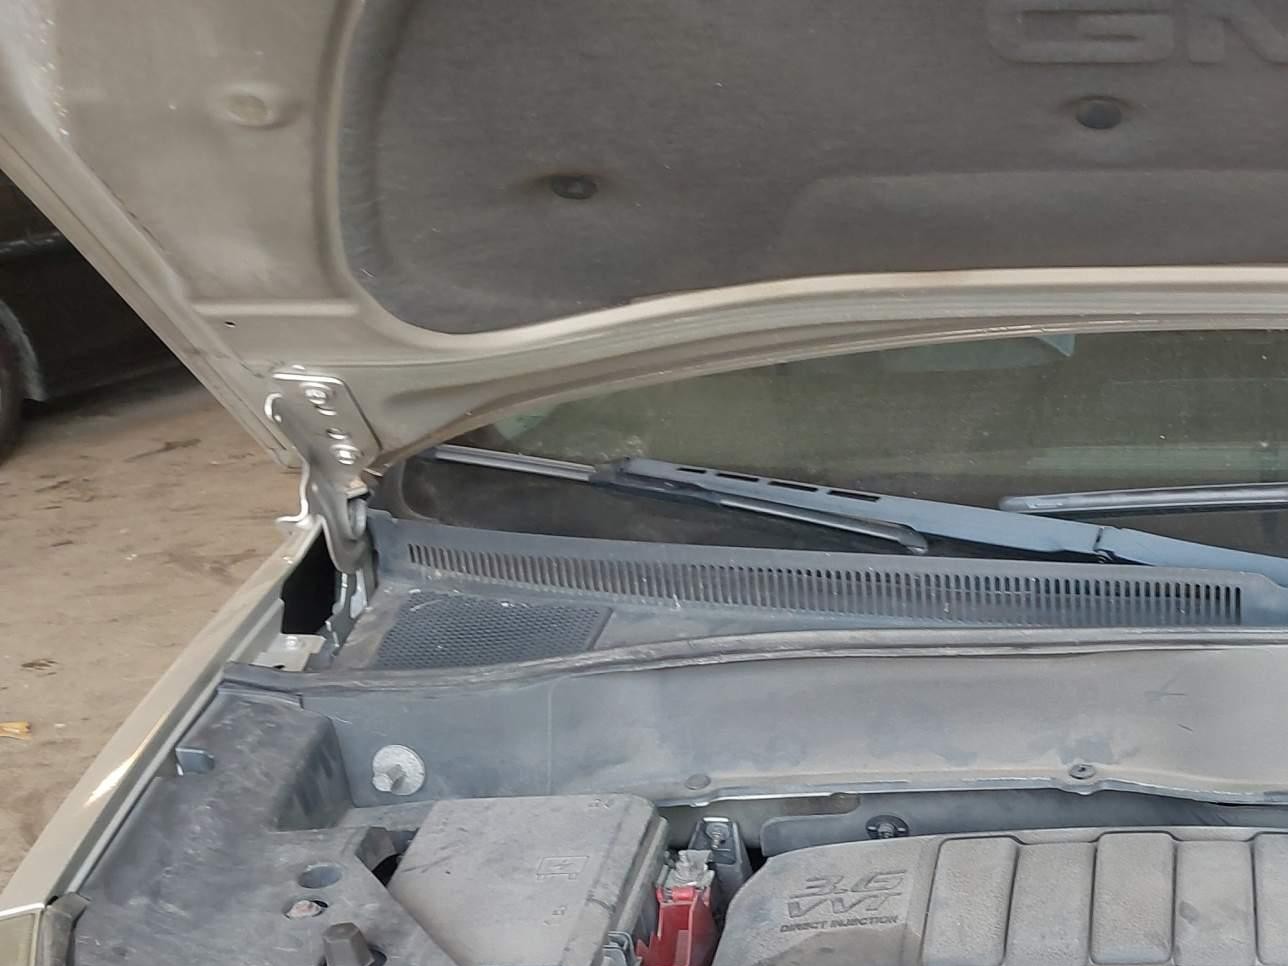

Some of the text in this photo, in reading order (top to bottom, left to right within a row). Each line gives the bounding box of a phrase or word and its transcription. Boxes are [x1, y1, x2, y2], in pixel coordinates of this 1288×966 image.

[789, 869, 908, 899] 3.6
[786, 892, 902, 919] VVT
[780, 915, 899, 933] DIRECT INJECTION
